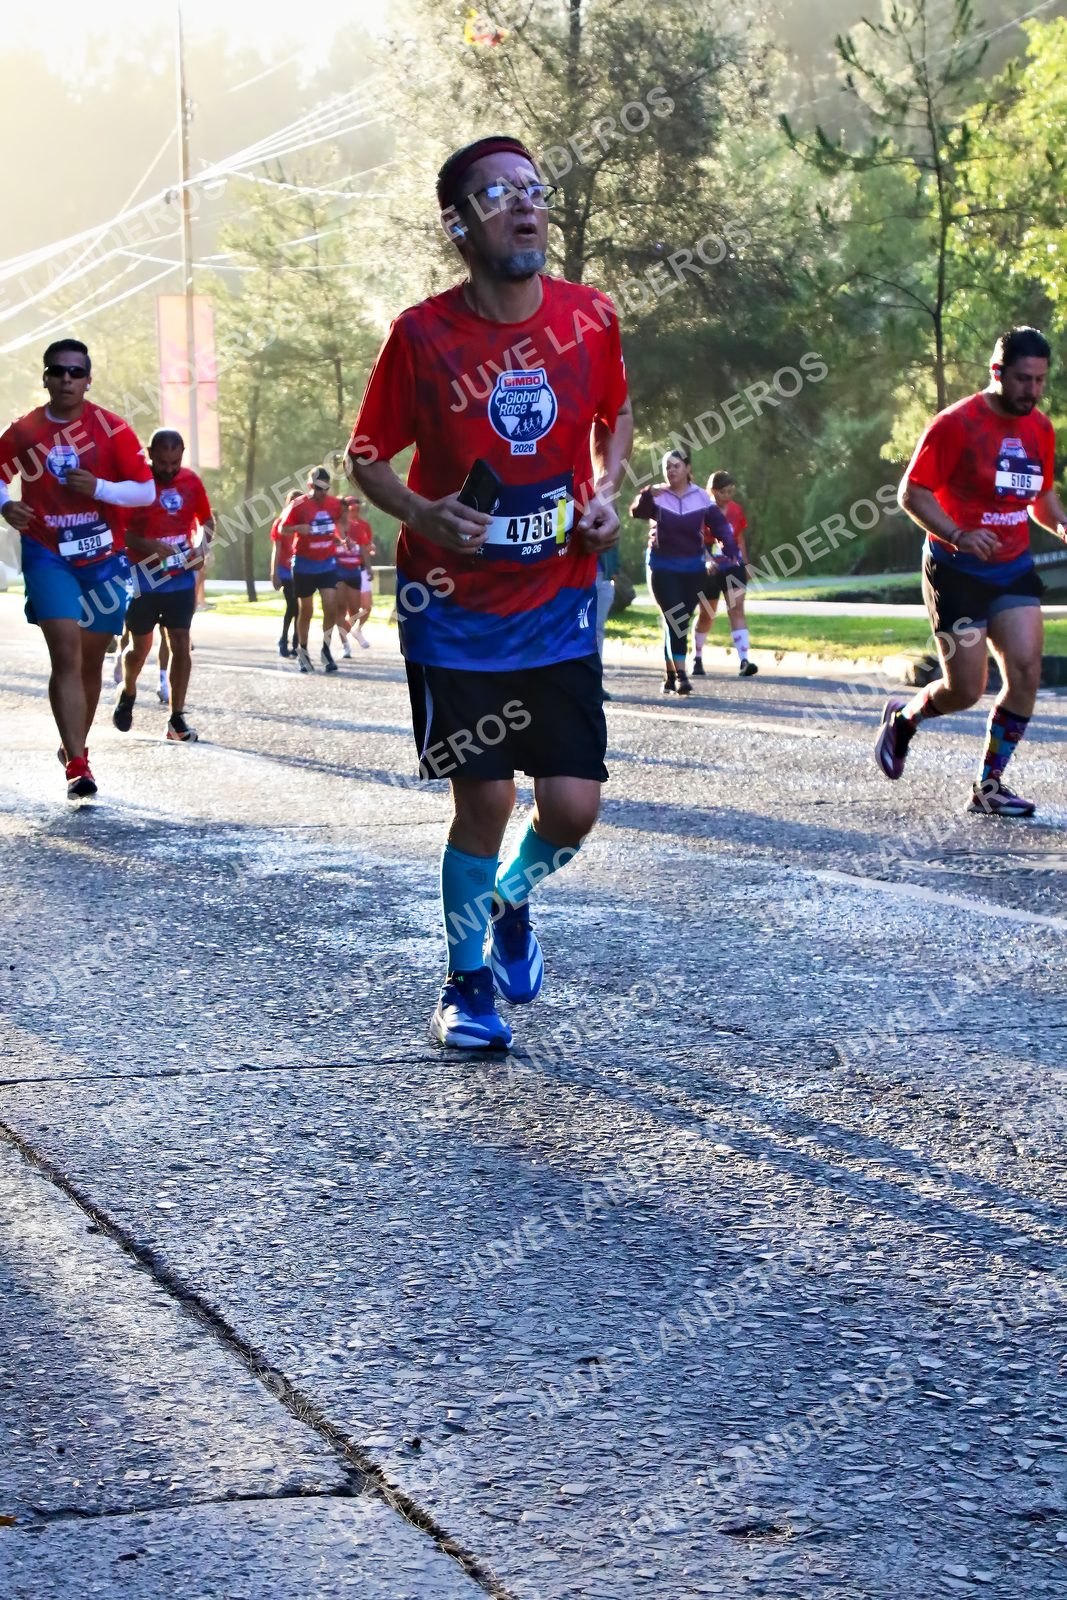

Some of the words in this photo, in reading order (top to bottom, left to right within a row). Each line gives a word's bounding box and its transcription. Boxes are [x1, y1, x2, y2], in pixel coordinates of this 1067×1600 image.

[504, 376, 541, 387] BIMBO
[506, 391, 540, 404] Global
[499, 403, 527, 416] Race
[513, 444, 534, 453] 2026
[1011, 474, 1032, 488] 5105
[44, 511, 99, 528] SANTIAGO
[506, 512, 552, 543] 4736
[78, 535, 102, 552] 4520
